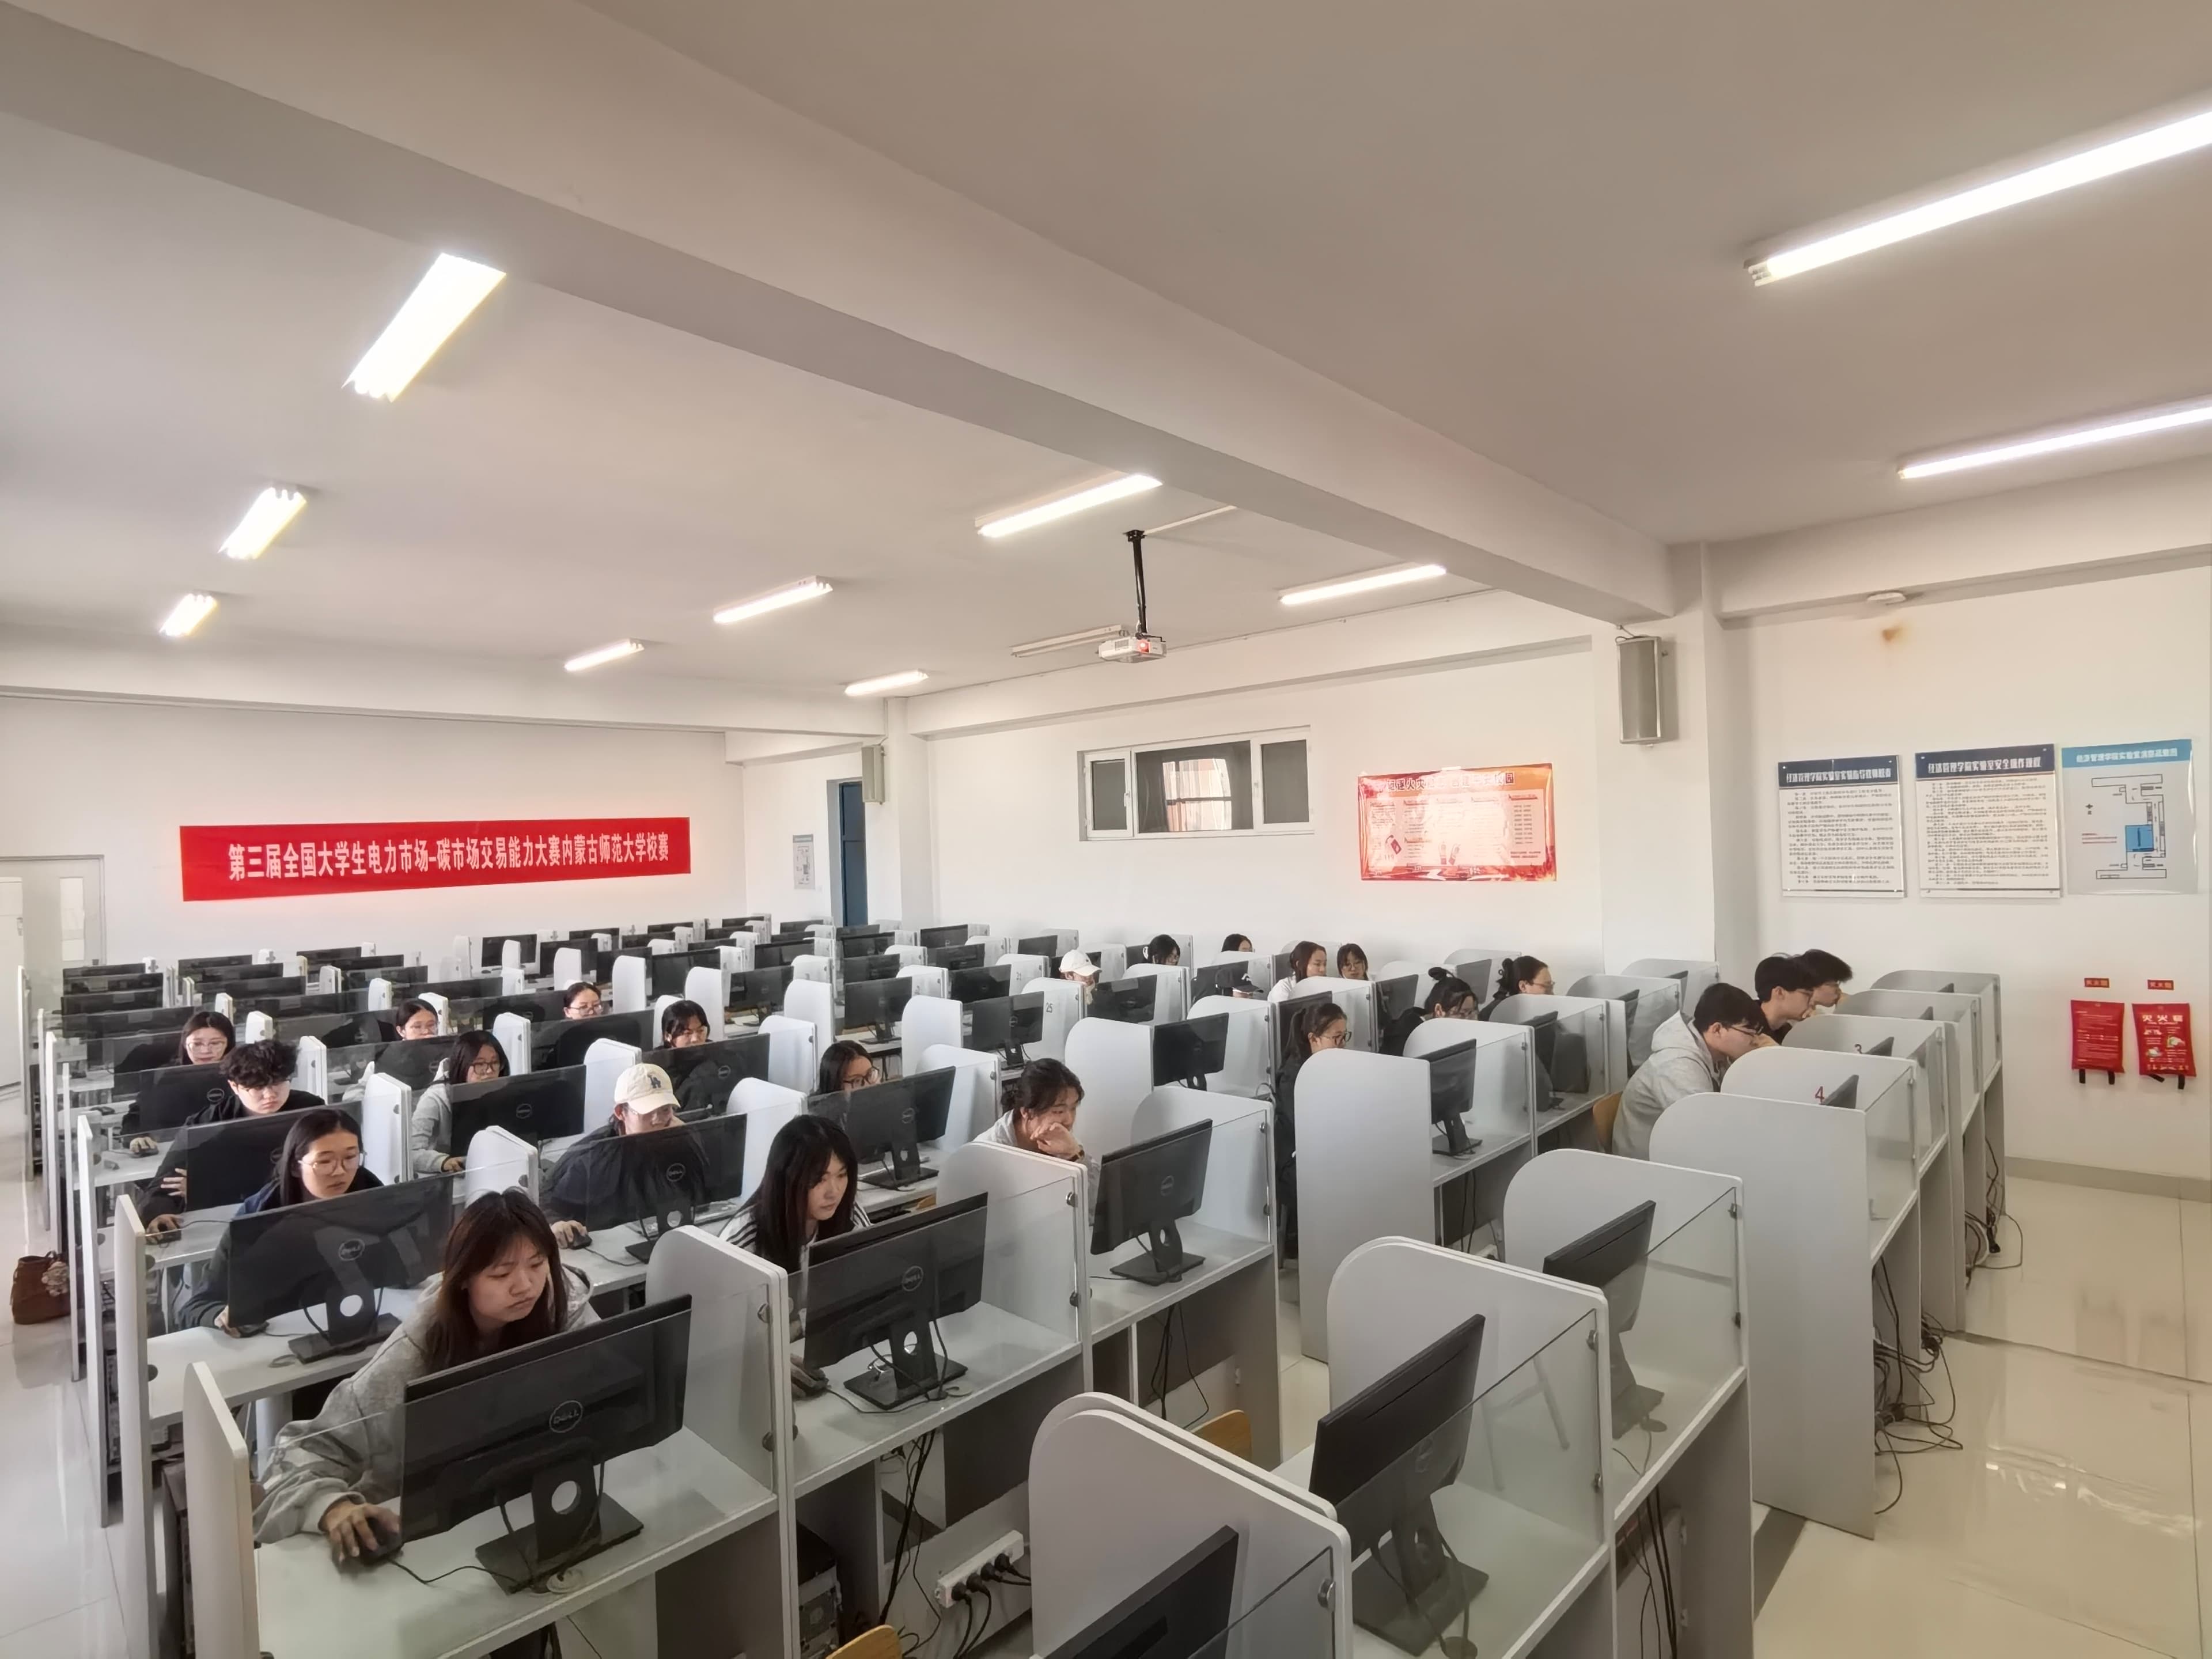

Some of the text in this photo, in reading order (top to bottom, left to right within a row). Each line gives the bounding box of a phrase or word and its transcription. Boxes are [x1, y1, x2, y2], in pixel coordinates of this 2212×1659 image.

[228, 832, 669, 881] 第三届全国大学生电力市场-碳市场交易能力大赛内蒙古师范大学校赛
[1046, 1002, 1054, 1013] 25
[1815, 1086, 1825, 1104] 4
